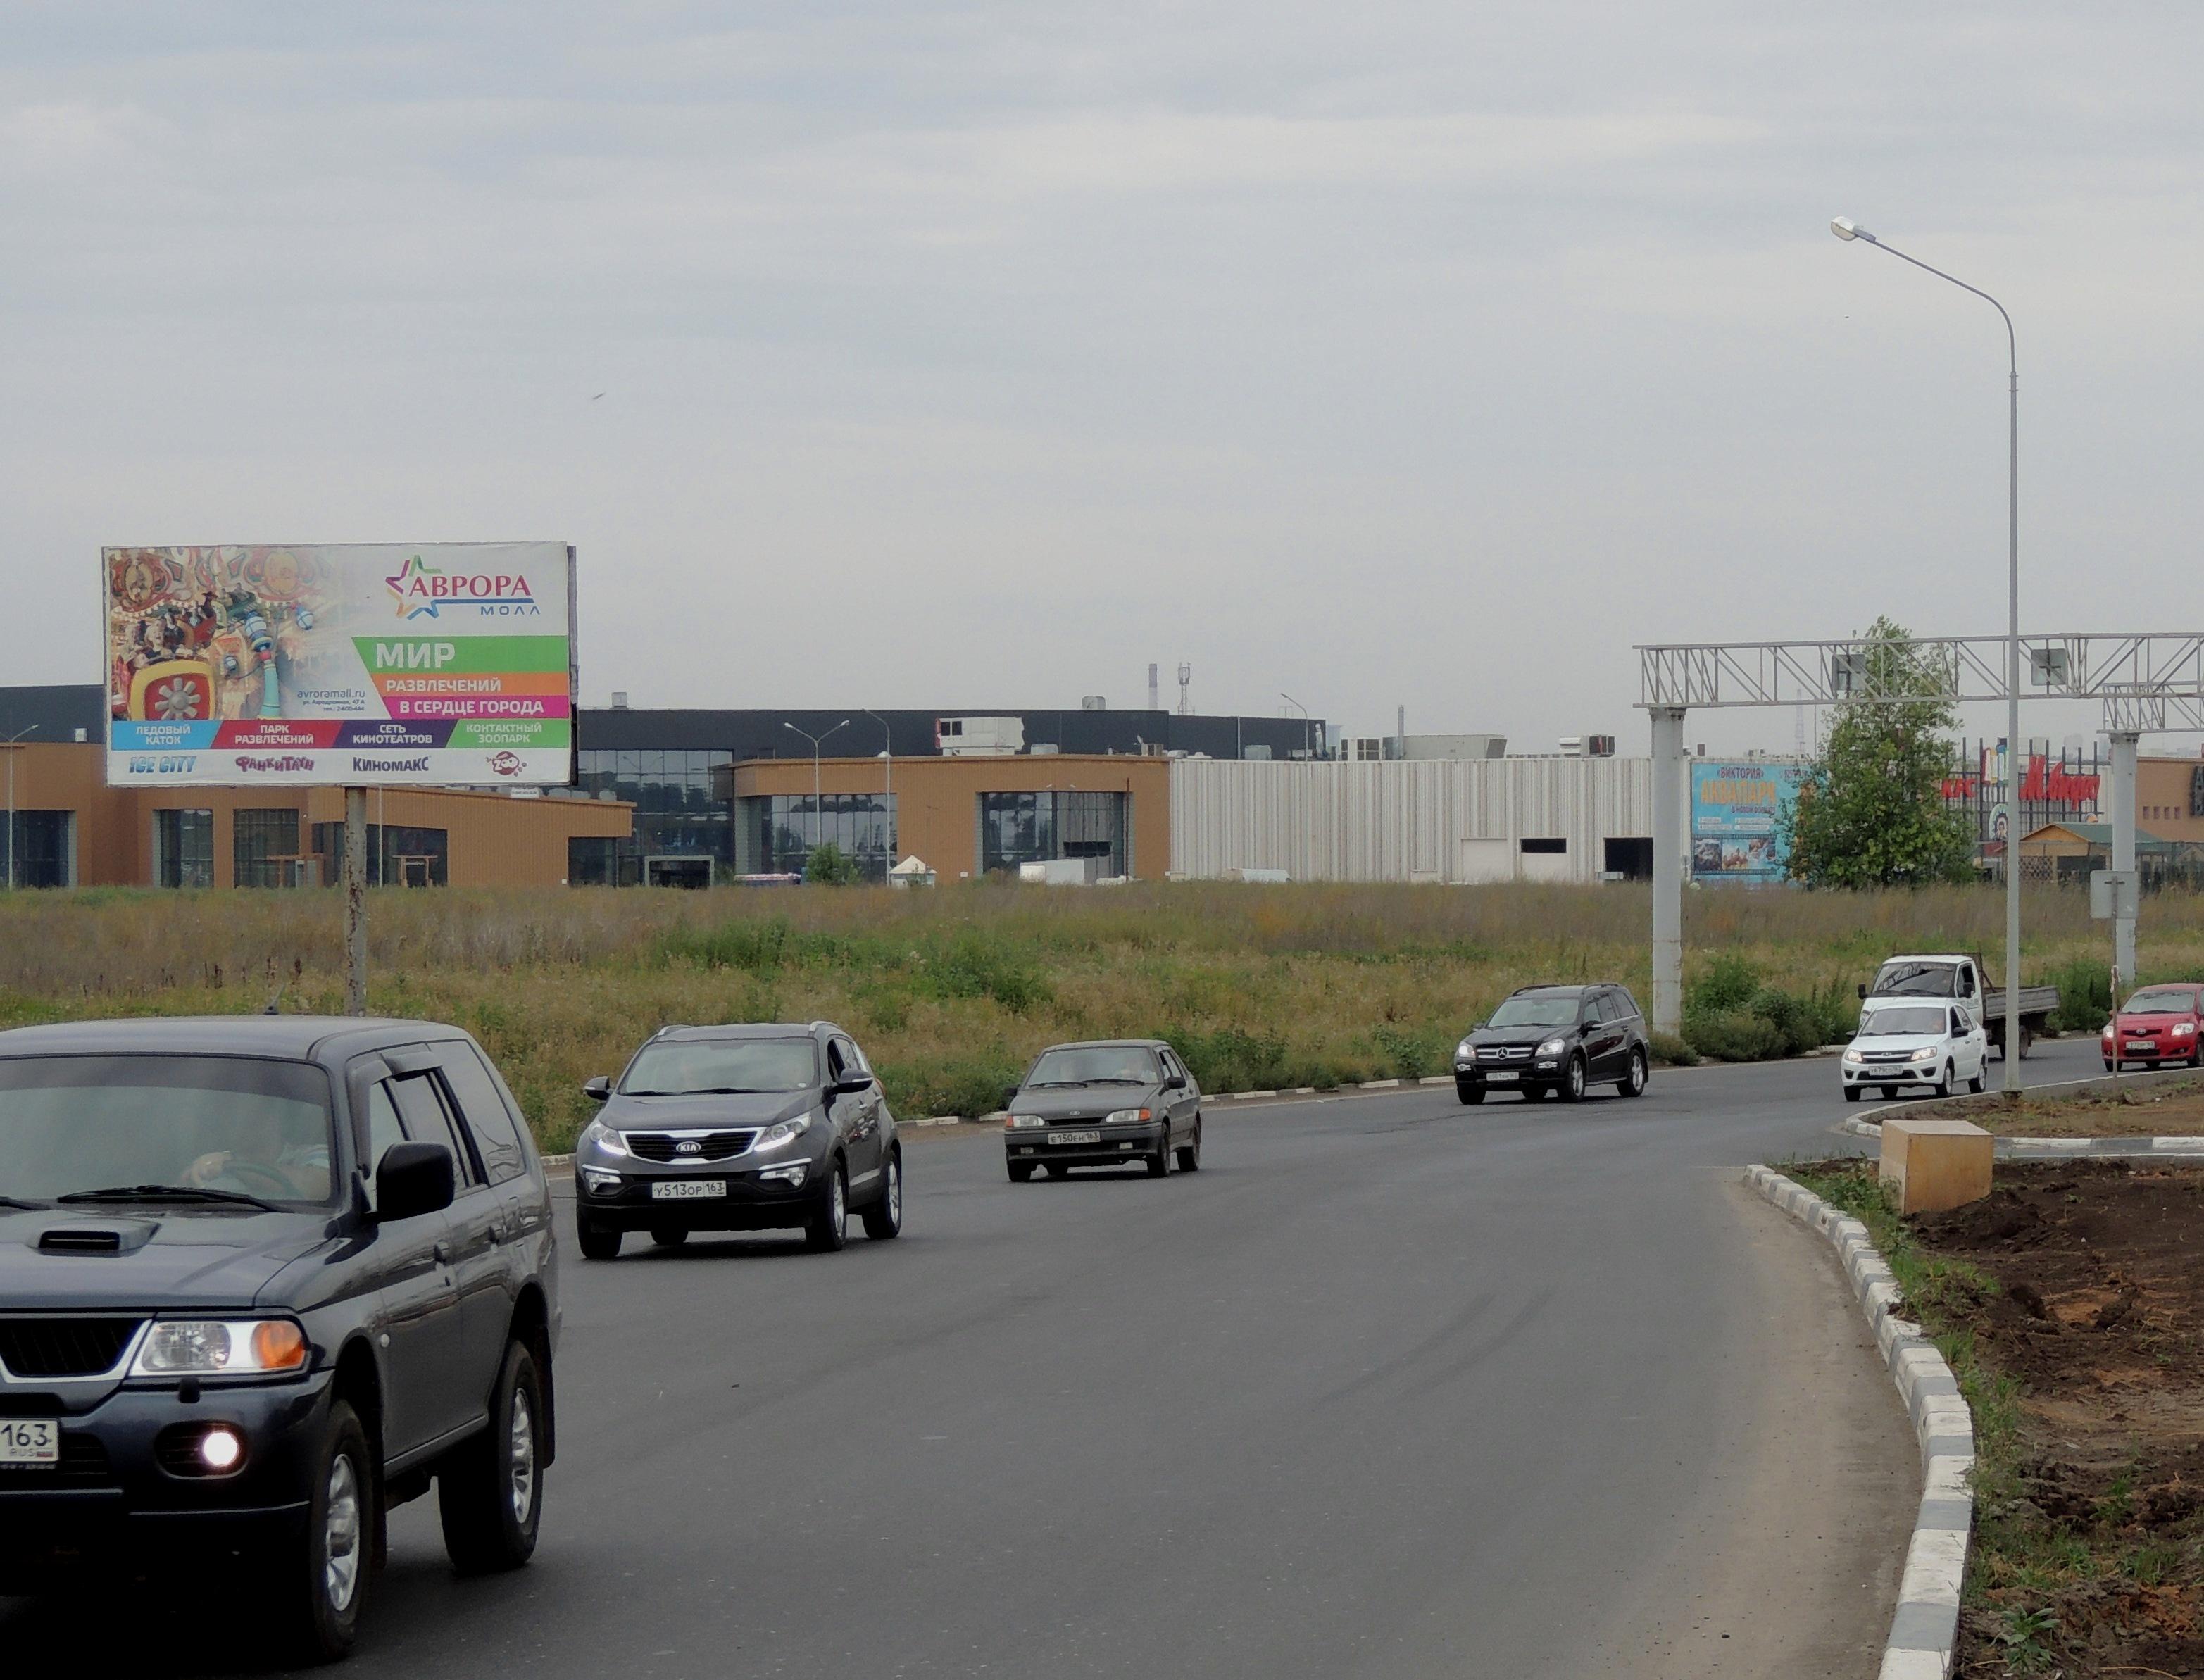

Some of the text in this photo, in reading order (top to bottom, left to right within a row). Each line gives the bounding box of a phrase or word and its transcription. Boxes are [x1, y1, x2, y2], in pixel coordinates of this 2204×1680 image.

[408, 575, 532, 597] АВРОРА
[480, 606, 541, 615] МОЛЛ
[377, 643, 456, 668] МИР
[387, 677, 501, 692] РАЗВЛЕЧЕНИЙ
[297, 689, 365, 698] avroramall.ru
[400, 701, 544, 715] В СЕРДЦЕ ГОРОДА
[136, 724, 191, 734] ЛЕДОВЫЙ
[261, 725, 289, 734] ПАРК
[379, 725, 406, 734] СЕТЬ
[466, 722, 542, 733] КОНТАКТНЫЙ
[146, 736, 181, 745] КАТОК
[235, 734, 314, 744] РАЗВЛЕЧЕНИЙ
[353, 734, 432, 744] КИНОТЕАТРОВ
[478, 734, 530, 744] ЗООПАРК
[130, 756, 196, 773] ICE CITY
[1941, 777, 1977, 798] KFC
[705, 1183, 722, 1191] 163
[1, 1424, 48, 1446] 163
